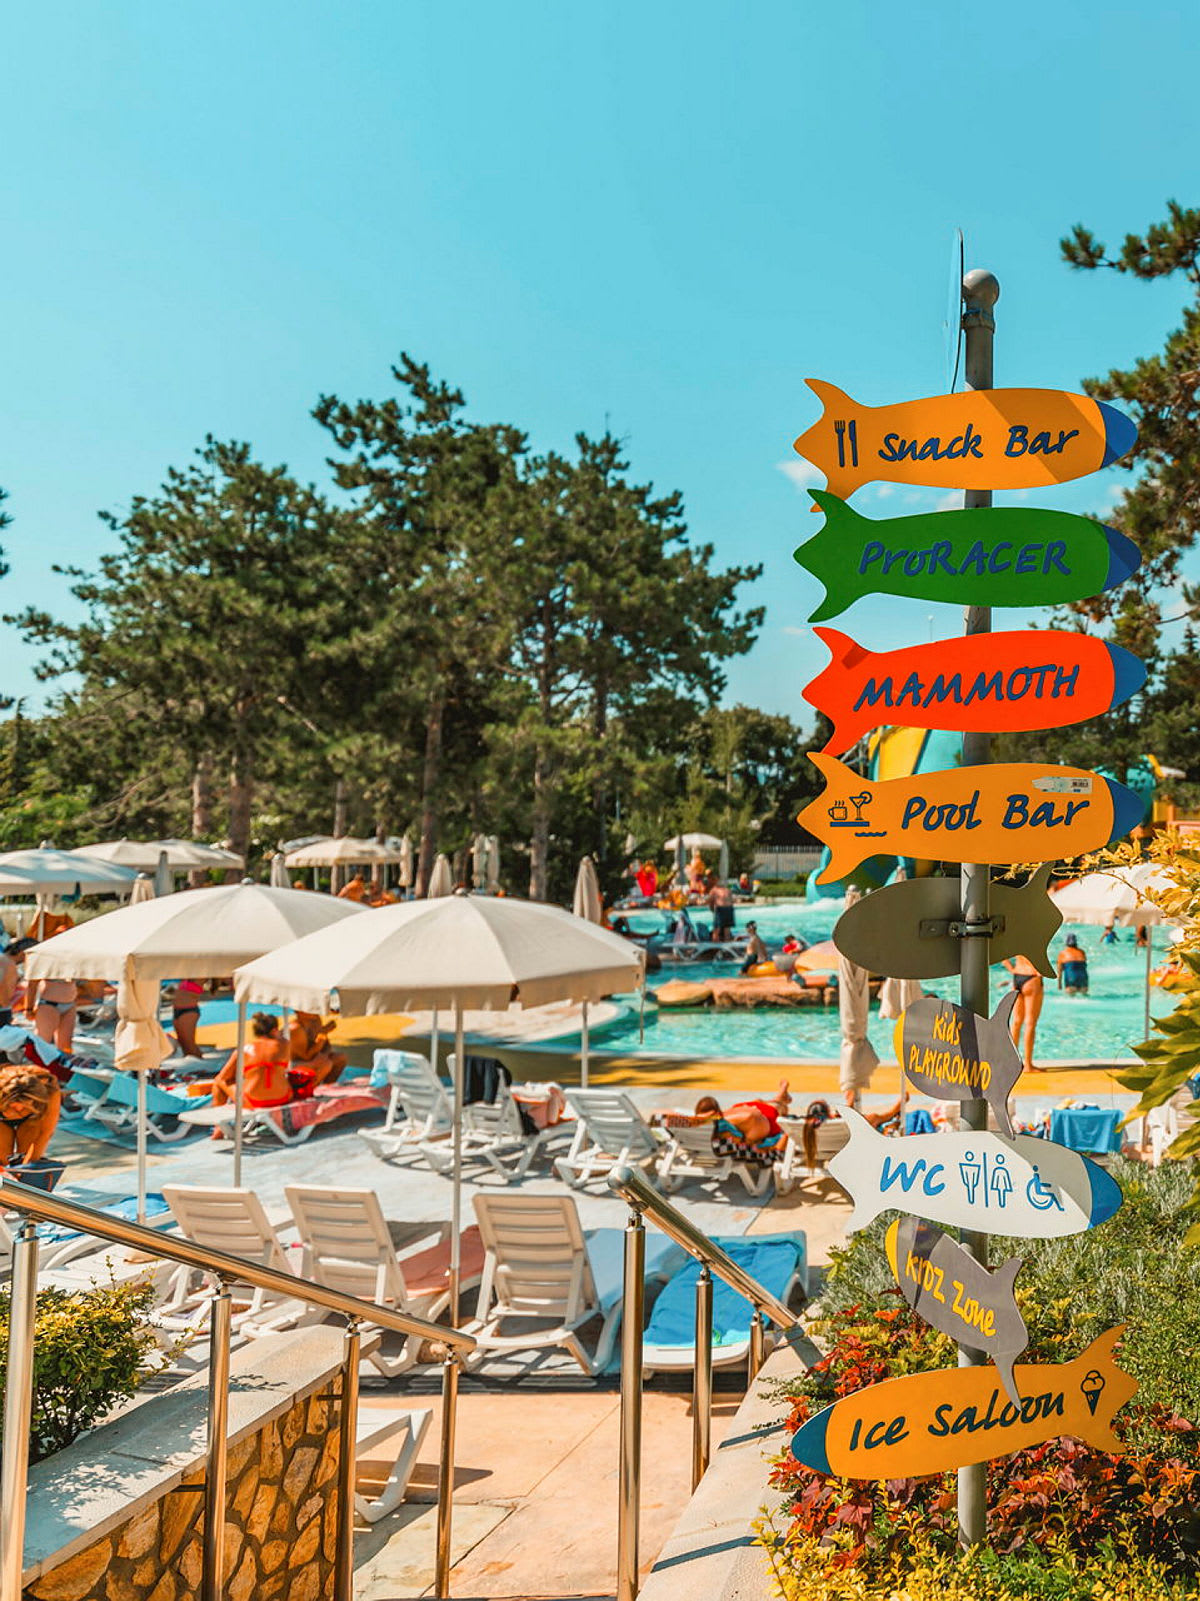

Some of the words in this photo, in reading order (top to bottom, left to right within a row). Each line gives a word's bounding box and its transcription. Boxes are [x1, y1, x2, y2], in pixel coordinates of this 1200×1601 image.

[878, 424, 984, 462] Snack
[1004, 425, 1079, 457] Bar
[857, 540, 1071, 576] ProRACER
[853, 664, 1080, 712] MAMMOTH
[901, 790, 982, 831] Pool
[1002, 794, 1090, 829] Bar
[909, 1044, 992, 1091] PLAYGROUND
[880, 1156, 945, 1196] WC
[952, 1280, 996, 1337] Zone
[849, 1416, 910, 1451] Ice
[927, 1389, 1065, 1438] Saloon
